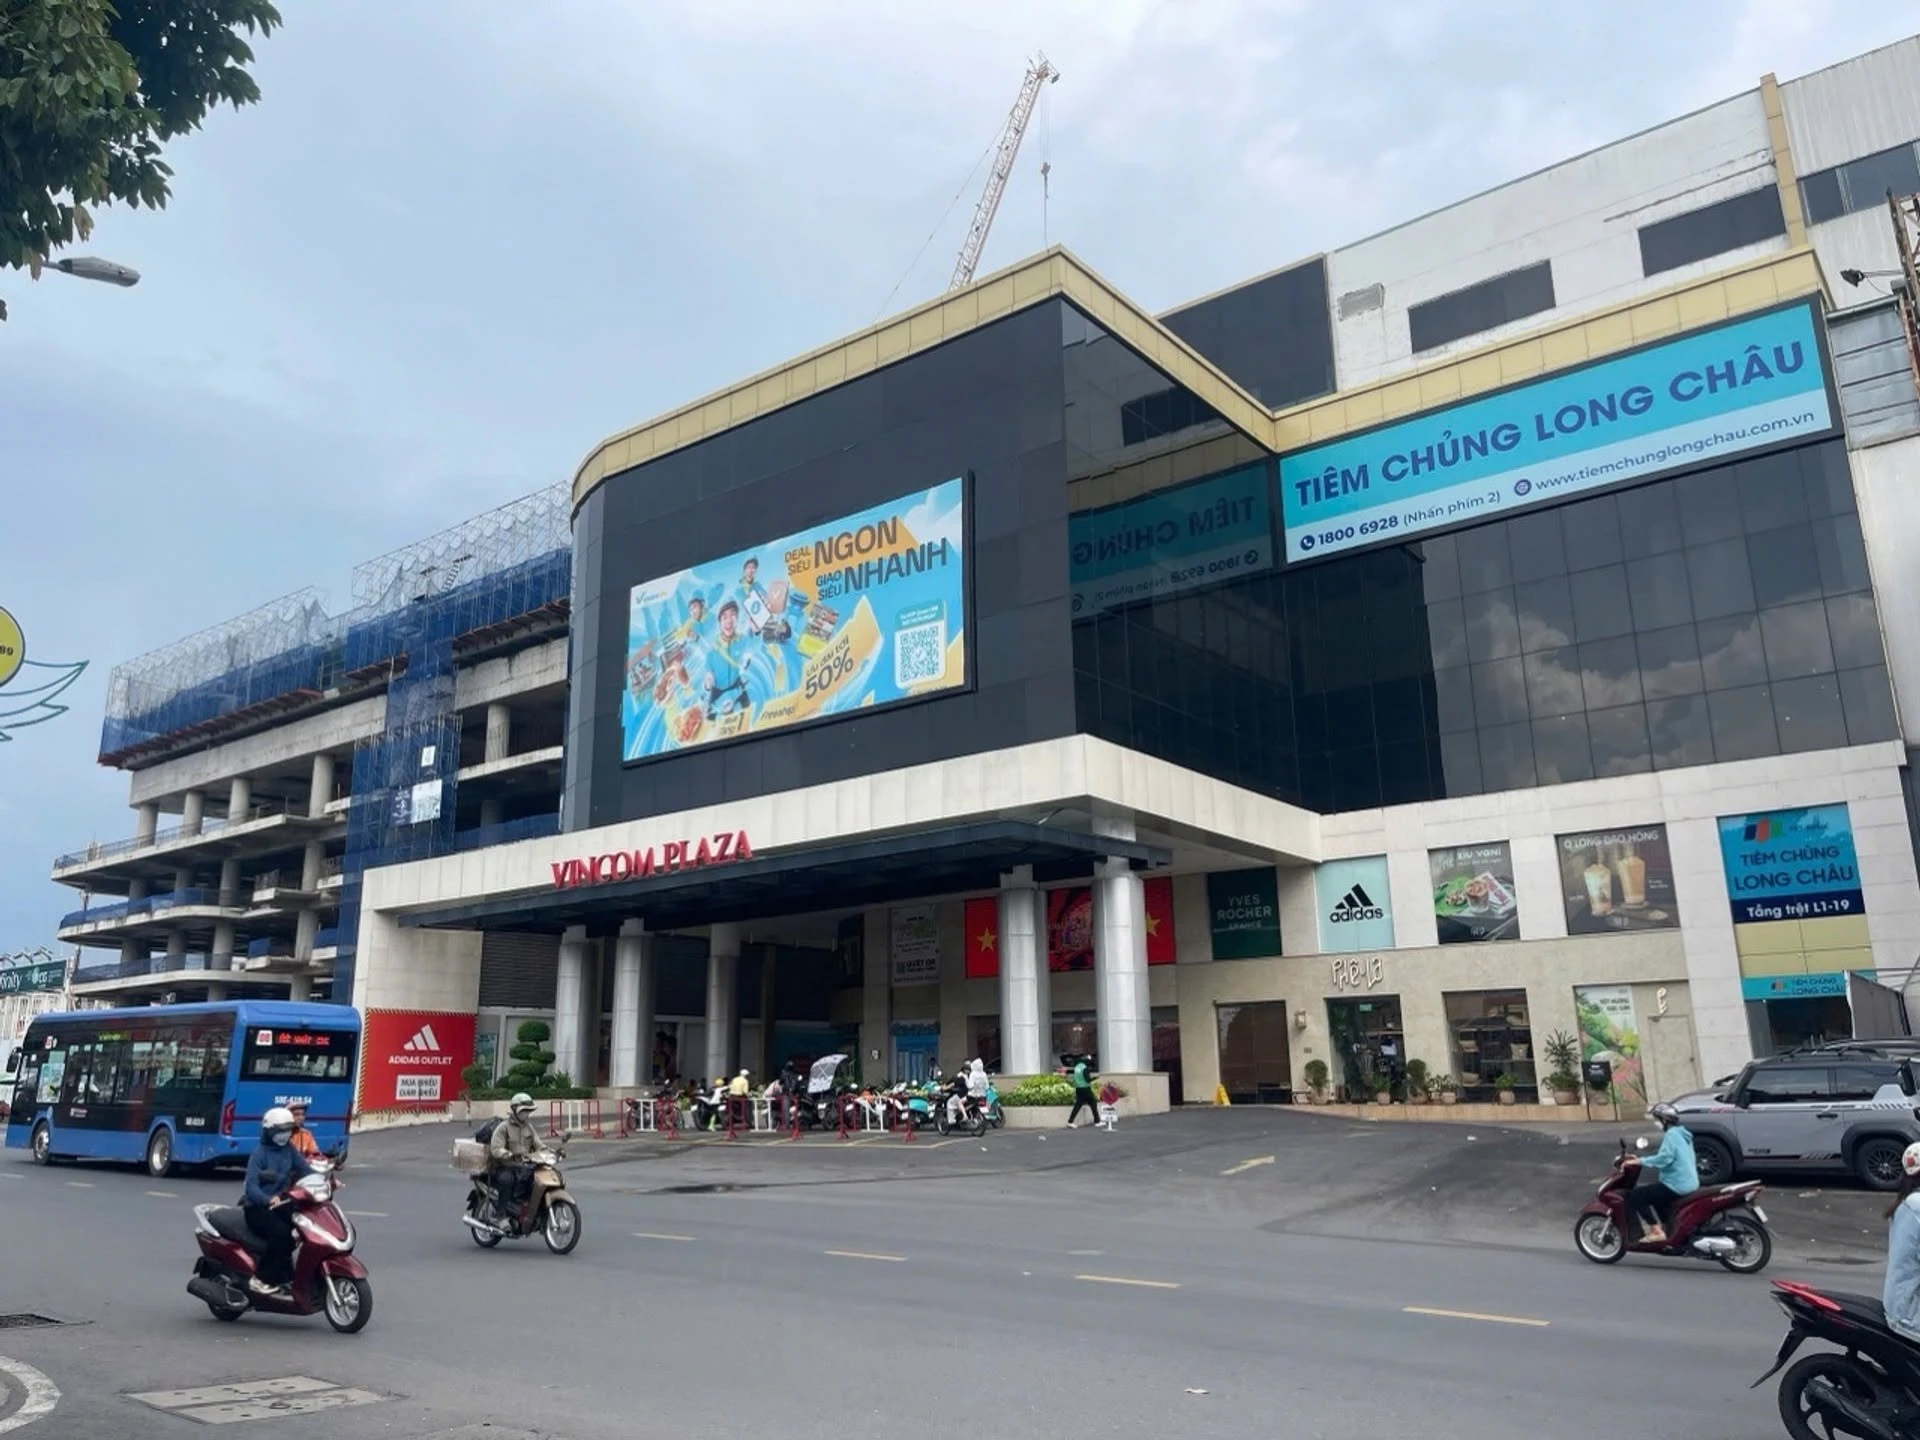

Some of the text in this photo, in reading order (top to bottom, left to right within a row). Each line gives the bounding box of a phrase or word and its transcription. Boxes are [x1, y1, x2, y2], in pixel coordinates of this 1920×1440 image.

[1295, 340, 1804, 506] TIÊM CHỦNG LONG CHÂU
[1536, 410, 1815, 490] www.tiemchunglongchau.com.vn
[1318, 525, 1354, 545] 1800
[1360, 515, 1399, 535] 6928
[1448, 496, 1485, 516] phím
[1488, 490, 1500, 505] 2)
[785, 545, 811, 563] DEAL
[814, 515, 897, 568] NGON
[845, 537, 947, 594] NHANH
[816, 570, 841, 587] GIAO
[805, 647, 854, 700] 50%
[551, 830, 752, 890] VINCOM PLAZA
[1740, 844, 1840, 867] TIÊM CHỦNG
[1734, 863, 1853, 891] LONG CHÂU
[1217, 905, 1272, 920] ROCHER
[1228, 894, 1260, 907] YVES
[1813, 899, 1850, 913] L1-19
[1329, 906, 1384, 923] adidas
[388, 1055, 453, 1064] ADIDAS OUTLET
